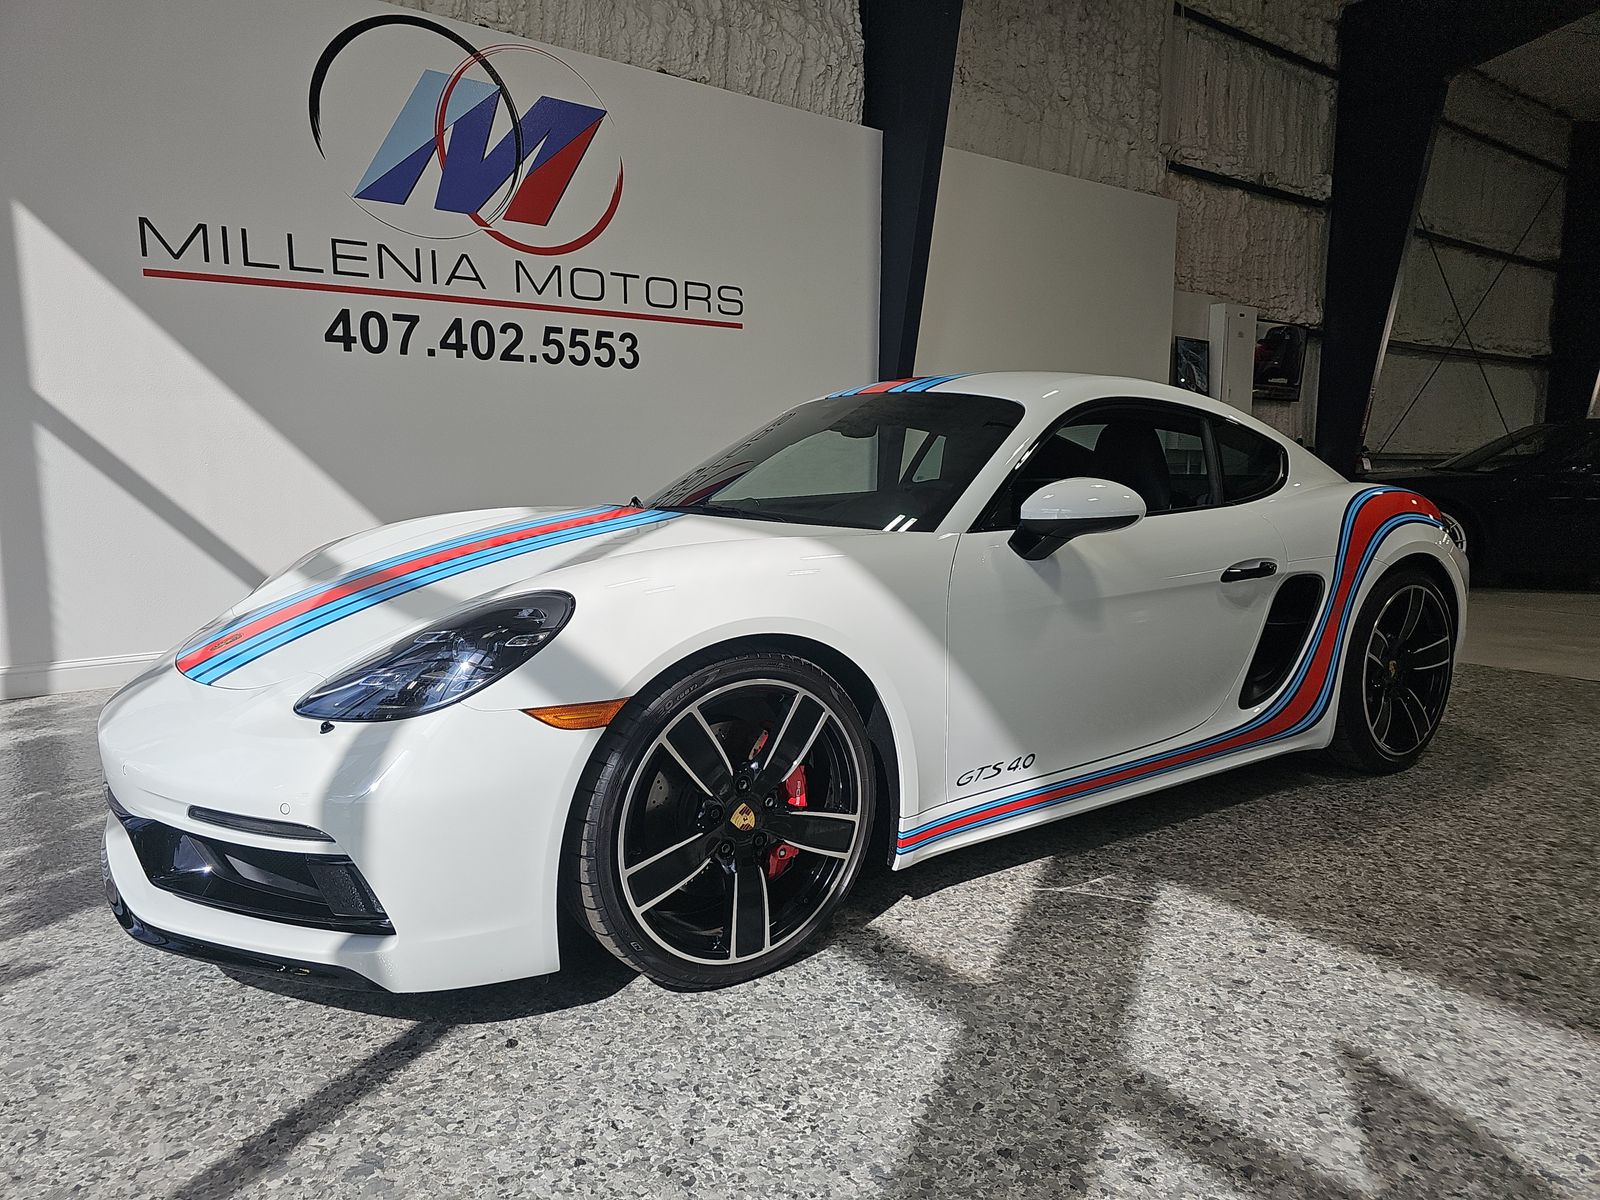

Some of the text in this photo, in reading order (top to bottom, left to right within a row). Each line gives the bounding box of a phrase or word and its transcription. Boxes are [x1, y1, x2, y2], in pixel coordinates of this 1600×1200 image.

[138, 216, 744, 316] MILLENIA MOTORS
[324, 308, 640, 370] 407.402.5553
[956, 753, 1035, 786] GTS 4.0
